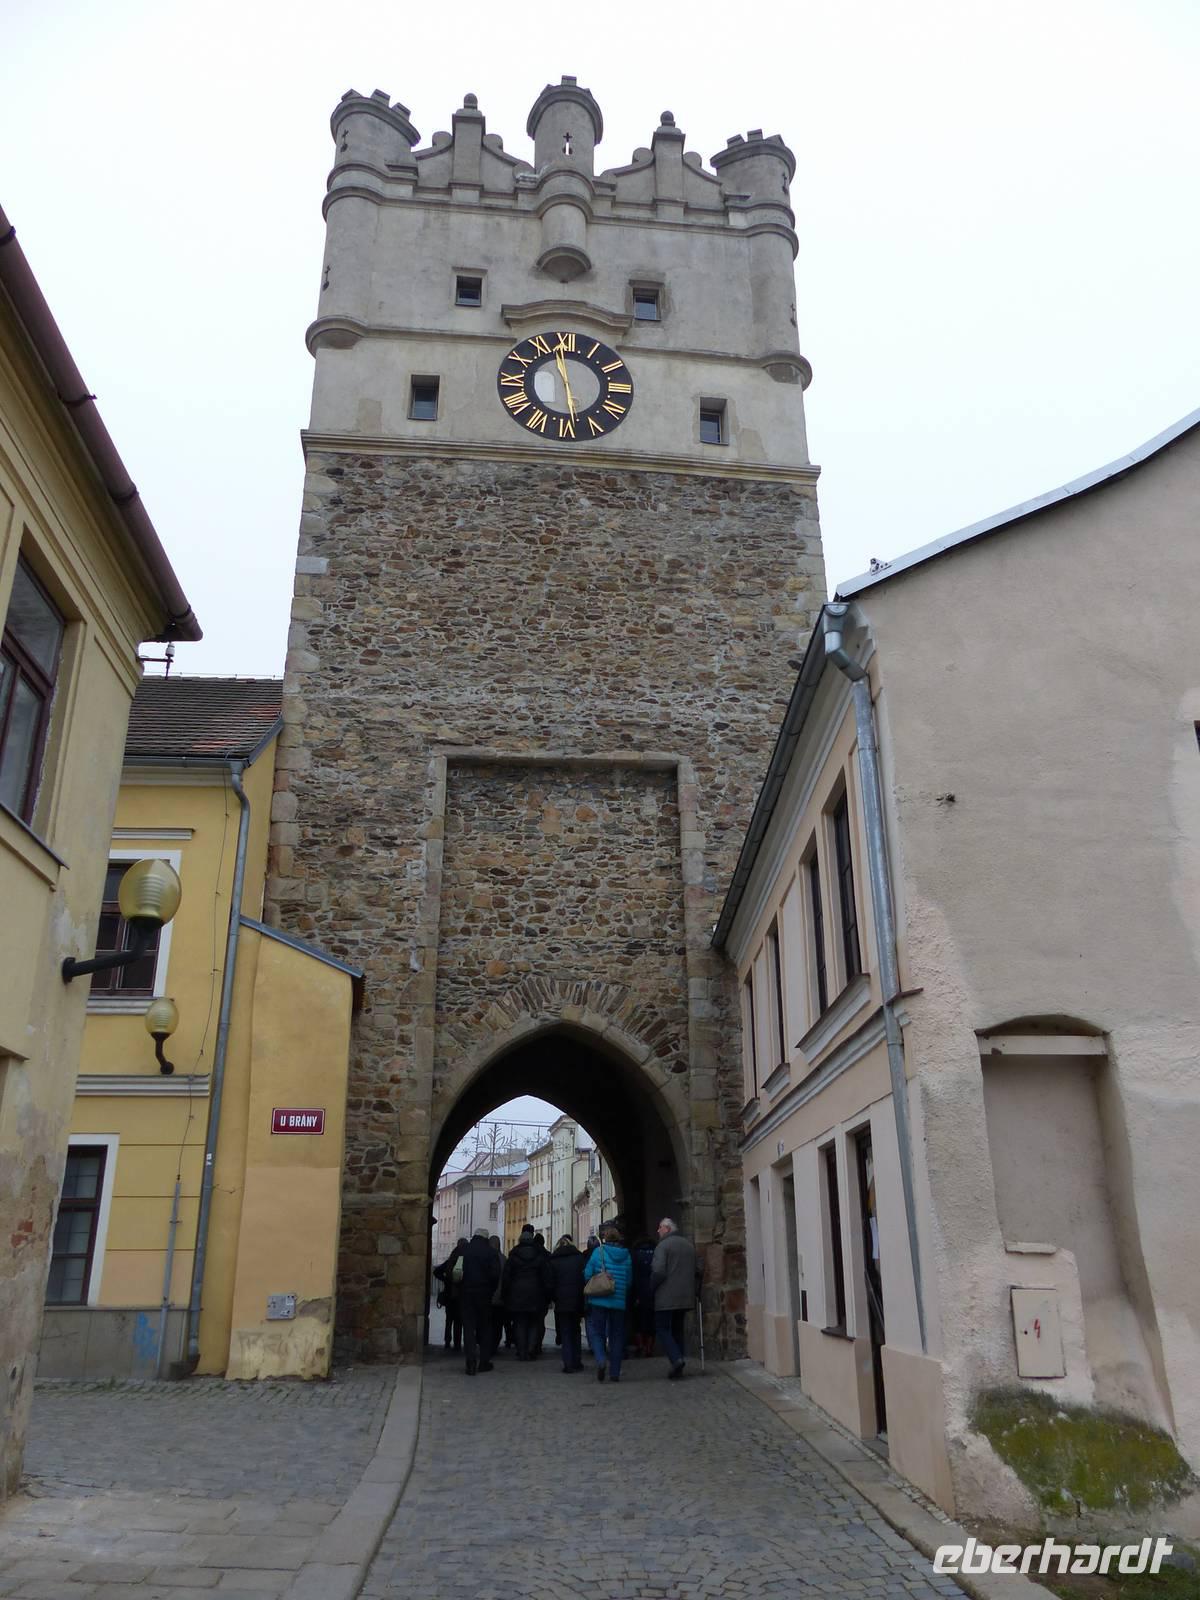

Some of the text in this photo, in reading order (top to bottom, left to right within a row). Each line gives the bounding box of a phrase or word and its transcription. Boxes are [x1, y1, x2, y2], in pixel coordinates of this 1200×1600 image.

[528, 335, 552, 357] XI
[553, 332, 576, 352] XII
[586, 342, 600, 359] I
[508, 350, 534, 368] X
[601, 360, 623, 373] II
[500, 371, 525, 387] IX
[608, 382, 632, 394] III
[503, 391, 531, 416] VIII
[602, 399, 627, 420] IV
[526, 408, 548, 433] VII
[558, 418, 576, 438] VI
[587, 416, 605, 436] V
[280, 1114, 317, 1127] U BRÁNY
